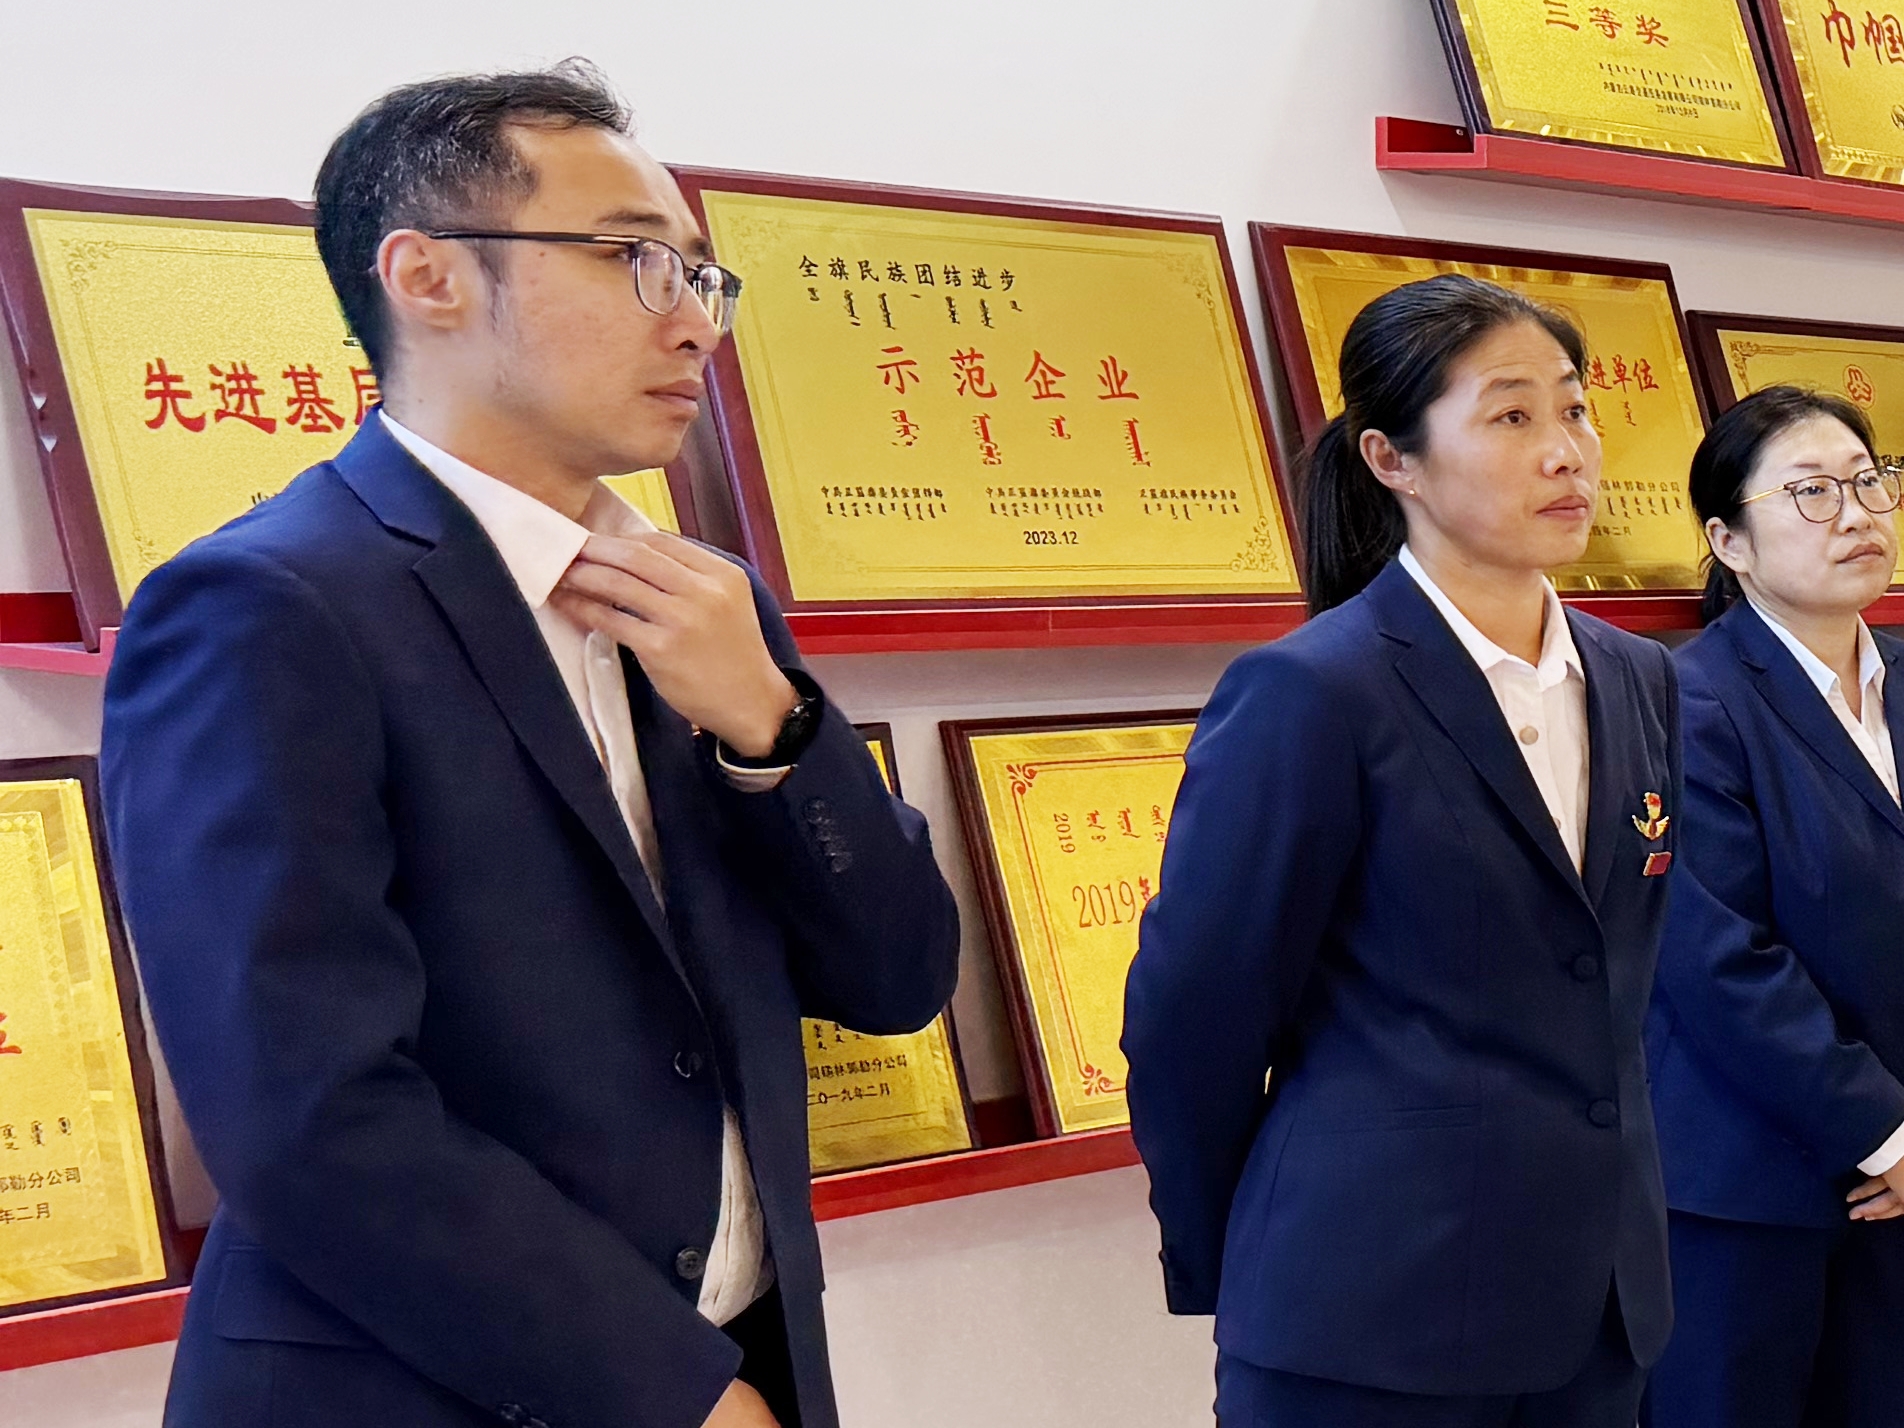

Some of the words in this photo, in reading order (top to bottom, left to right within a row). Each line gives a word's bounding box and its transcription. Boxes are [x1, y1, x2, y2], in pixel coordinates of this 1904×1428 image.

[799, 254, 1016, 292] 全旗民族团结进步
[876, 345, 1140, 402] 示范企业
[1583, 347, 1661, 394] 进单位
[1598, 478, 1681, 493] 锡林郭勒分公司
[1022, 529, 1080, 546] 2023.12
[1052, 812, 1077, 854] 2019
